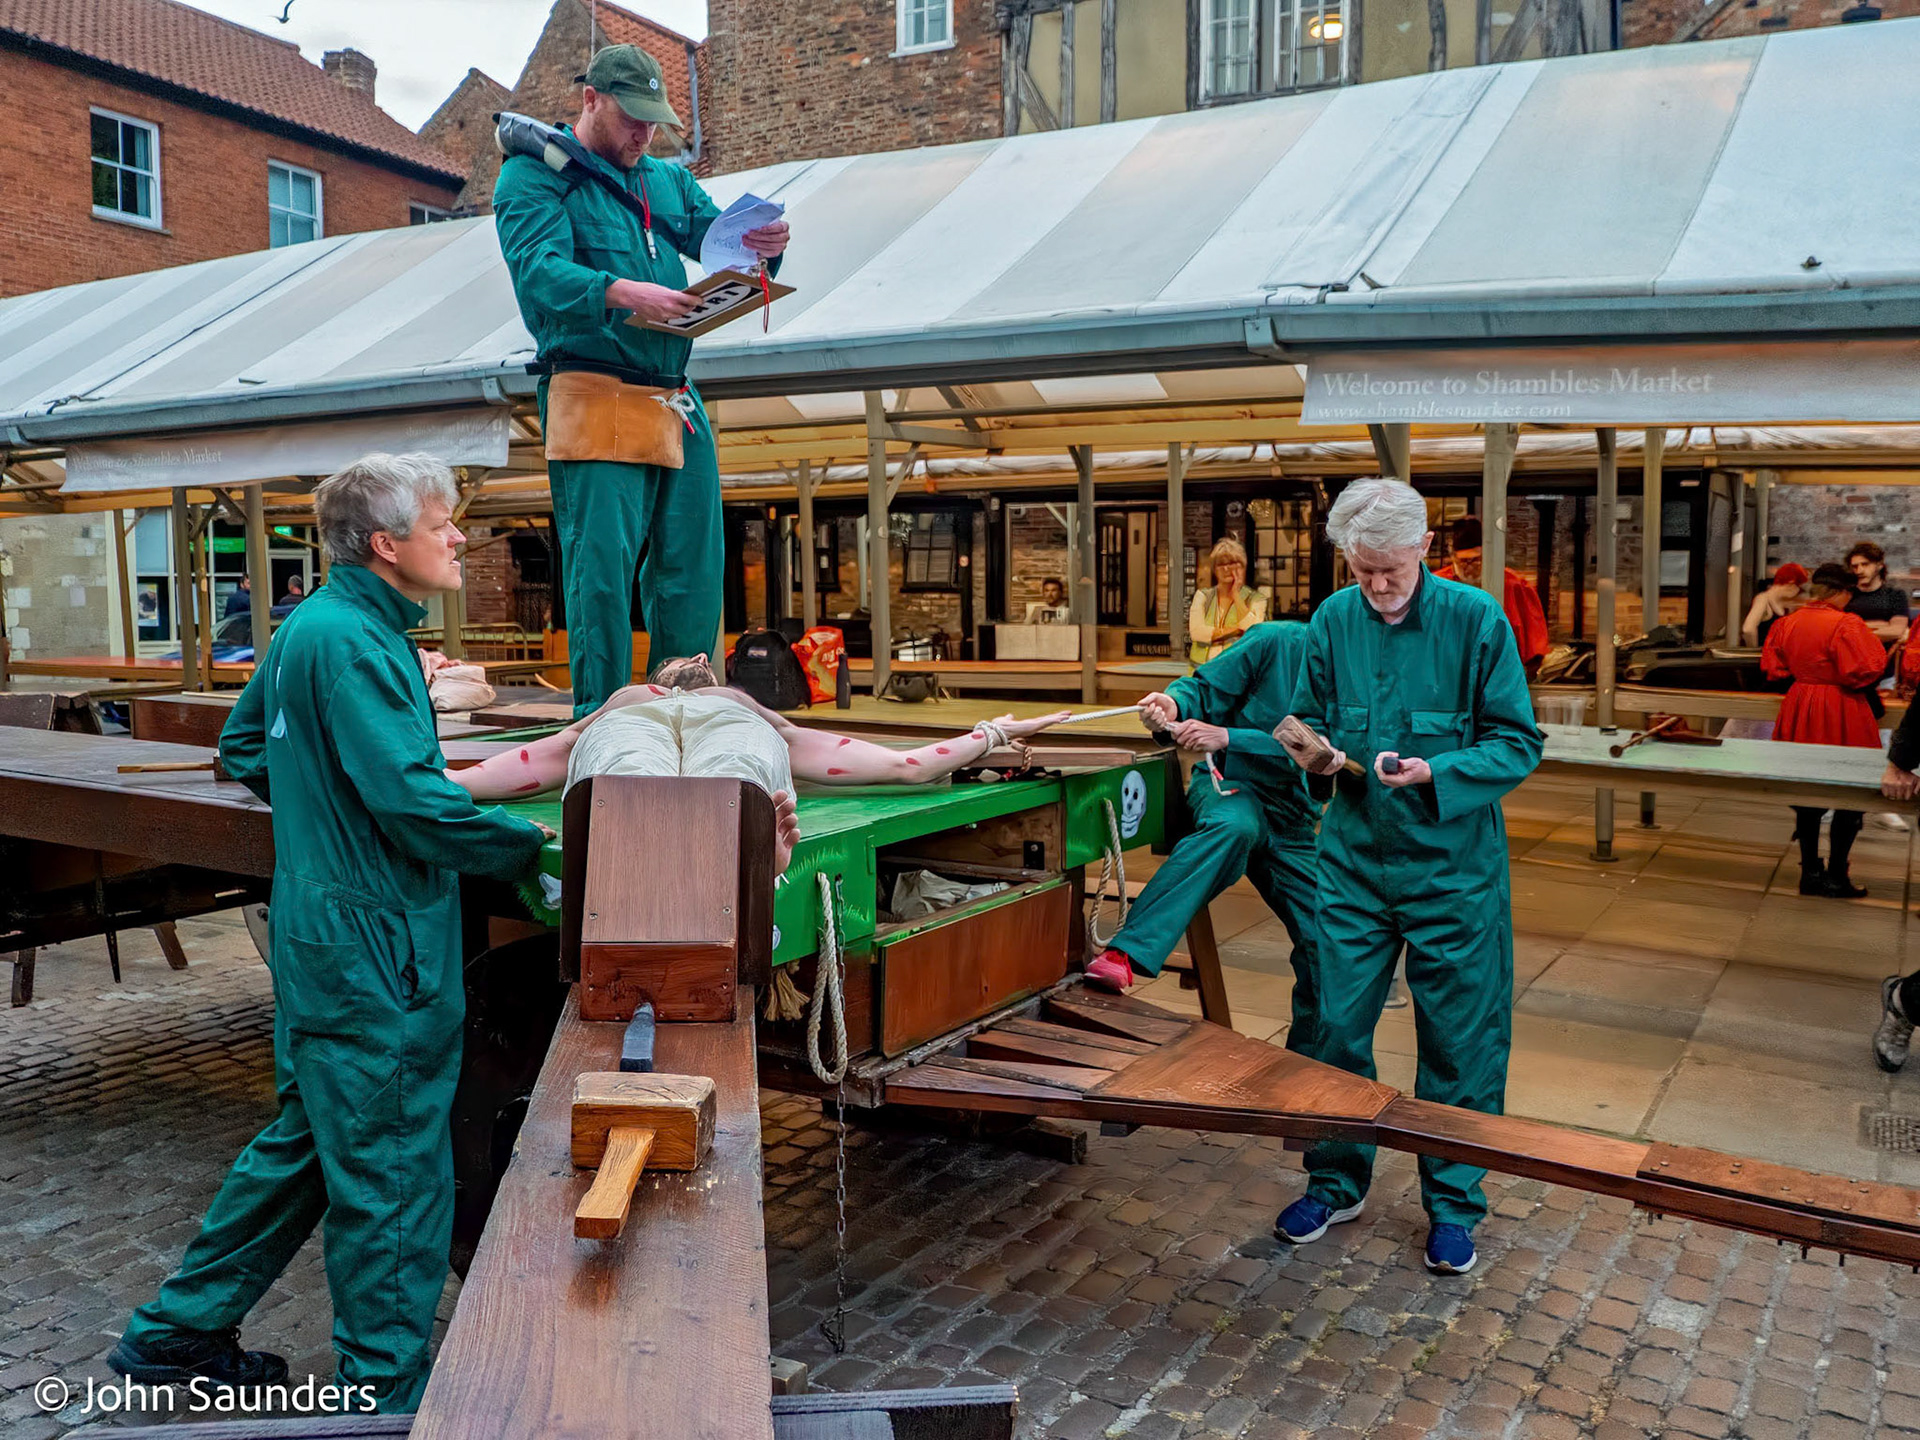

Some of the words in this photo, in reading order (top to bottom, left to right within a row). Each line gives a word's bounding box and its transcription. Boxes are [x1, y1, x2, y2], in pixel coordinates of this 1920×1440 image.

[1322, 372, 1434, 396] Welcome
[1442, 376, 1466, 395] to
[1474, 369, 1599, 395] Shambles
[1608, 367, 1714, 393] Market
